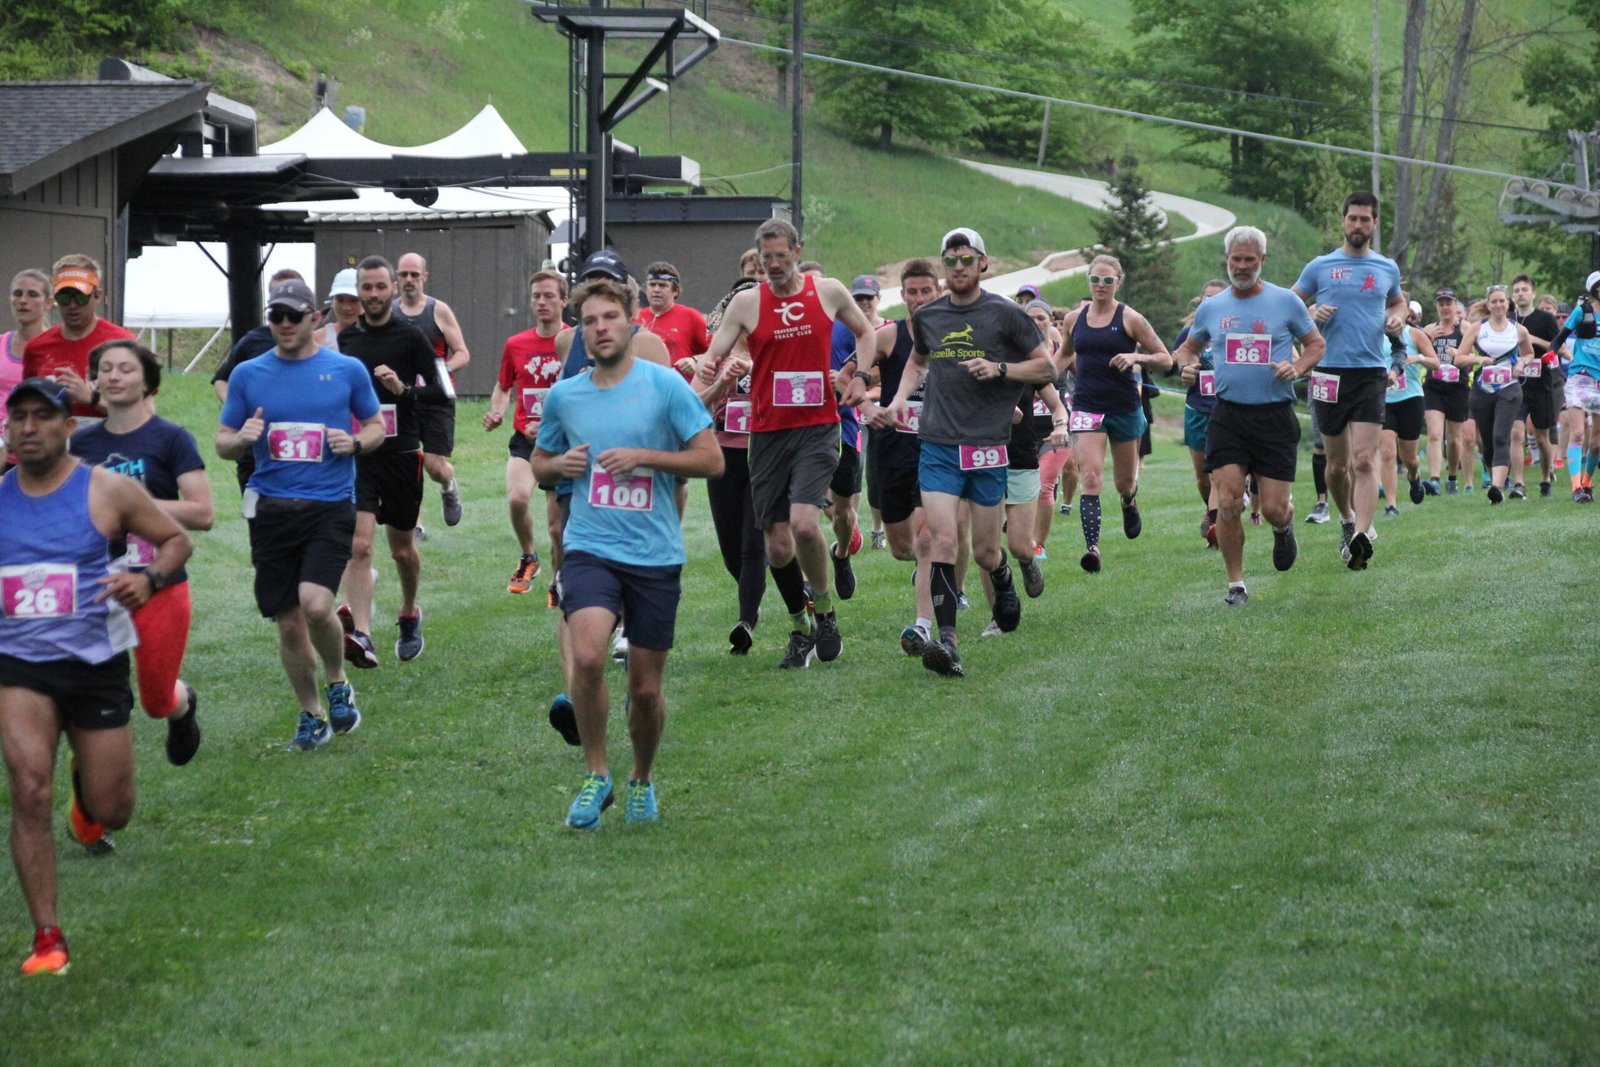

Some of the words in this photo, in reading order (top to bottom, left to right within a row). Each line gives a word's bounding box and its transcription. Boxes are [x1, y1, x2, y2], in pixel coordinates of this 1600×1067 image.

[773, 326, 799, 335] TRAVERSE
[774, 332, 794, 340] TRACK
[796, 329, 812, 337] CLUB
[957, 348, 986, 360] Sports
[1235, 347, 1260, 362] 86
[791, 387, 806, 404] 8
[1312, 384, 1329, 400] 85
[1072, 416, 1093, 429] 33
[278, 439, 308, 459] 31
[971, 449, 1000, 467] 99
[596, 484, 648, 508] 100
[14, 587, 58, 615] 26
